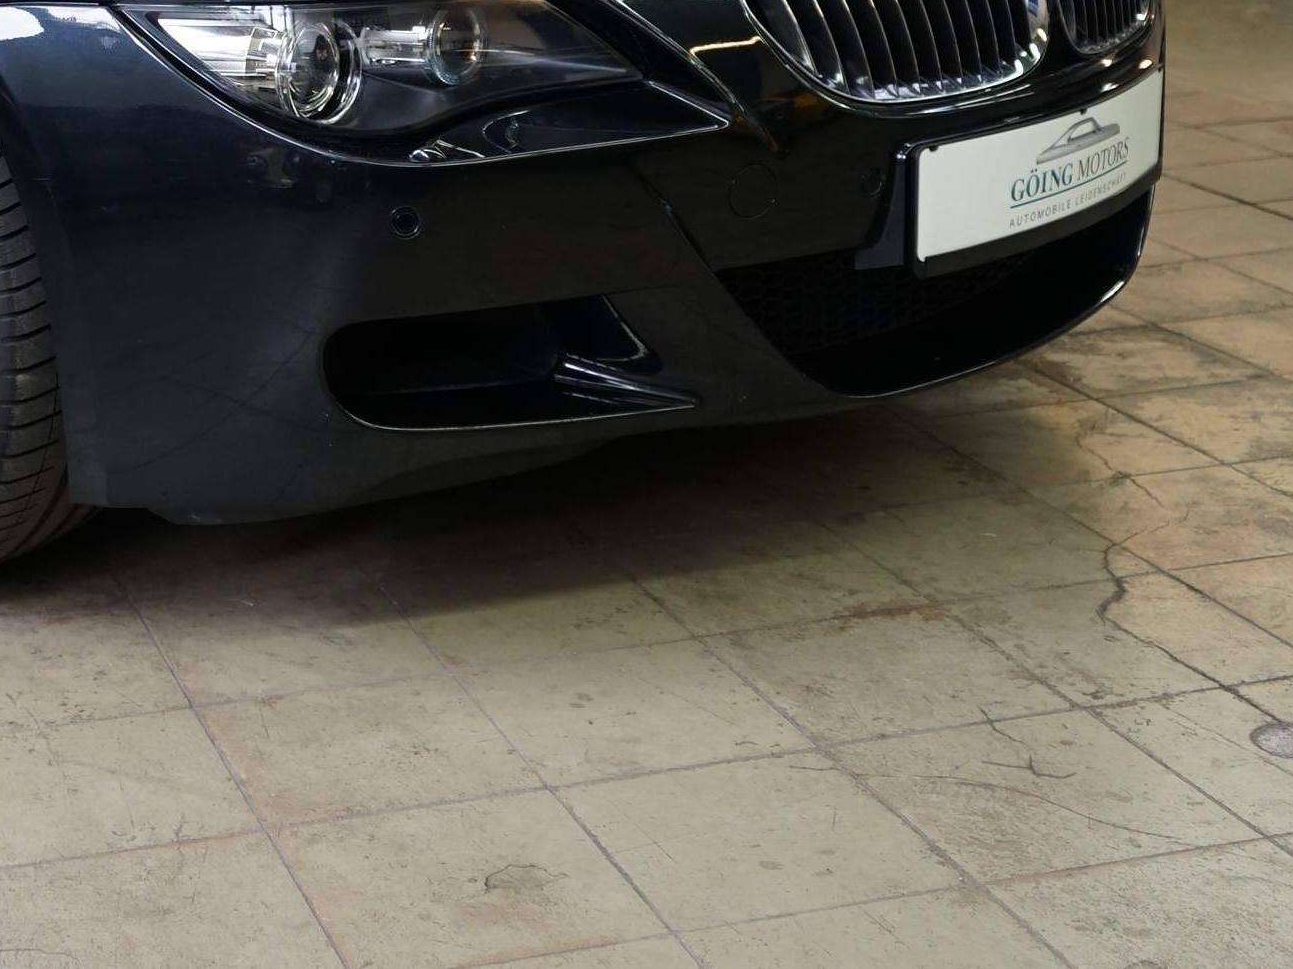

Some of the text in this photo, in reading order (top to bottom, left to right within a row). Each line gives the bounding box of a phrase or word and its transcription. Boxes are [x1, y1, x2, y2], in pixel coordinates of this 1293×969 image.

[1011, 140, 1129, 201] GÖING MOTORS
[1009, 200, 1071, 230] AUTOMOBILE
